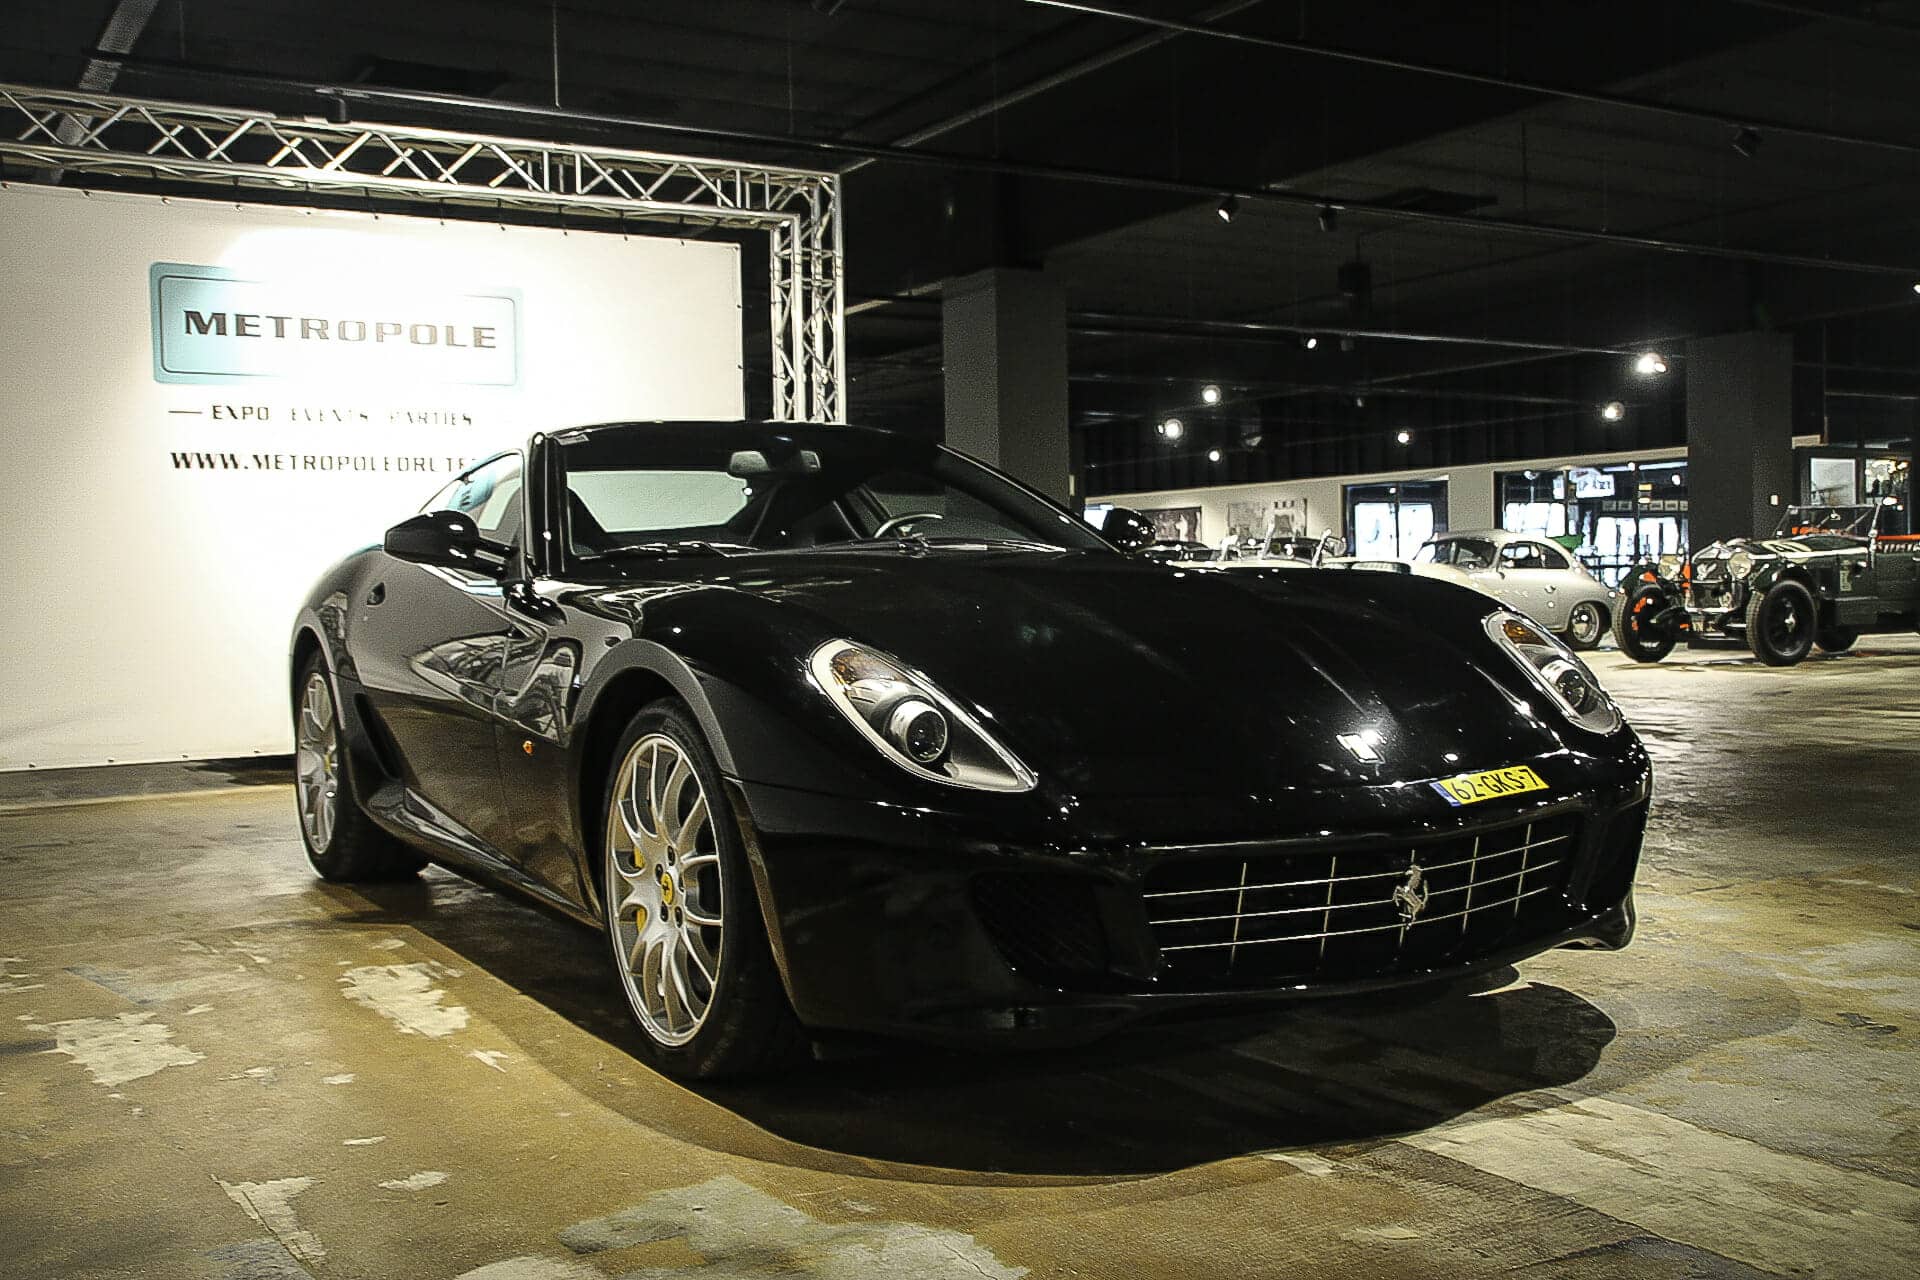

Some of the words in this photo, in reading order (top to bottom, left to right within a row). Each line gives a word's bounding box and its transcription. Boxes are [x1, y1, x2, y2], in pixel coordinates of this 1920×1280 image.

[183, 309, 497, 349] METROPOLE
[212, 404, 270, 421] EXPO
[291, 407, 369, 422] EVENS
[389, 409, 473, 426] ARTIES
[1451, 768, 1540, 800] 62-GKS-7
